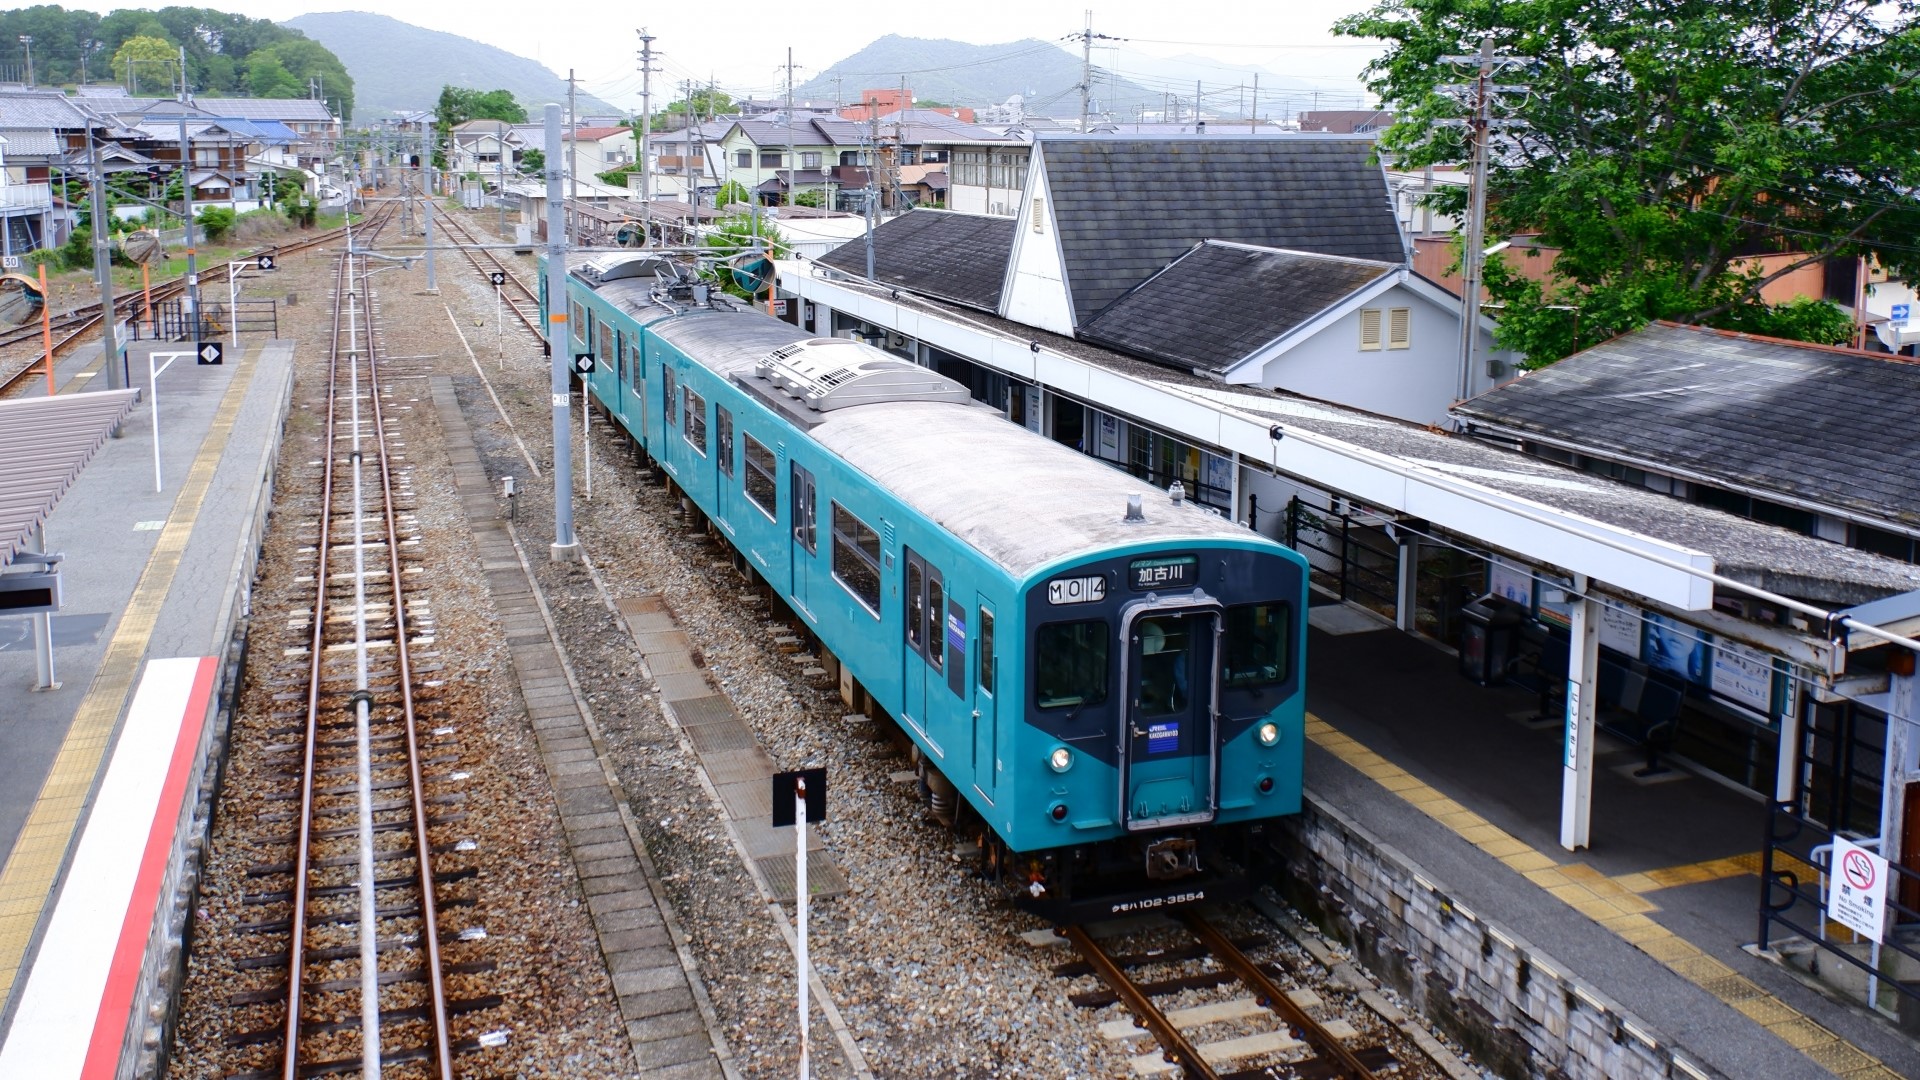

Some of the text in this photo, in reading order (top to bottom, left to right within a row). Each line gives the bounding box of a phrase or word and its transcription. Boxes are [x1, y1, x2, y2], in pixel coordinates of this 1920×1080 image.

[5, 257, 17, 267] 30
[1138, 565, 1183, 582] 加古川
[1569, 692, 1579, 759] にしわきし
[1839, 895, 1848, 904] No
[1848, 900, 1875, 919] Smoking
